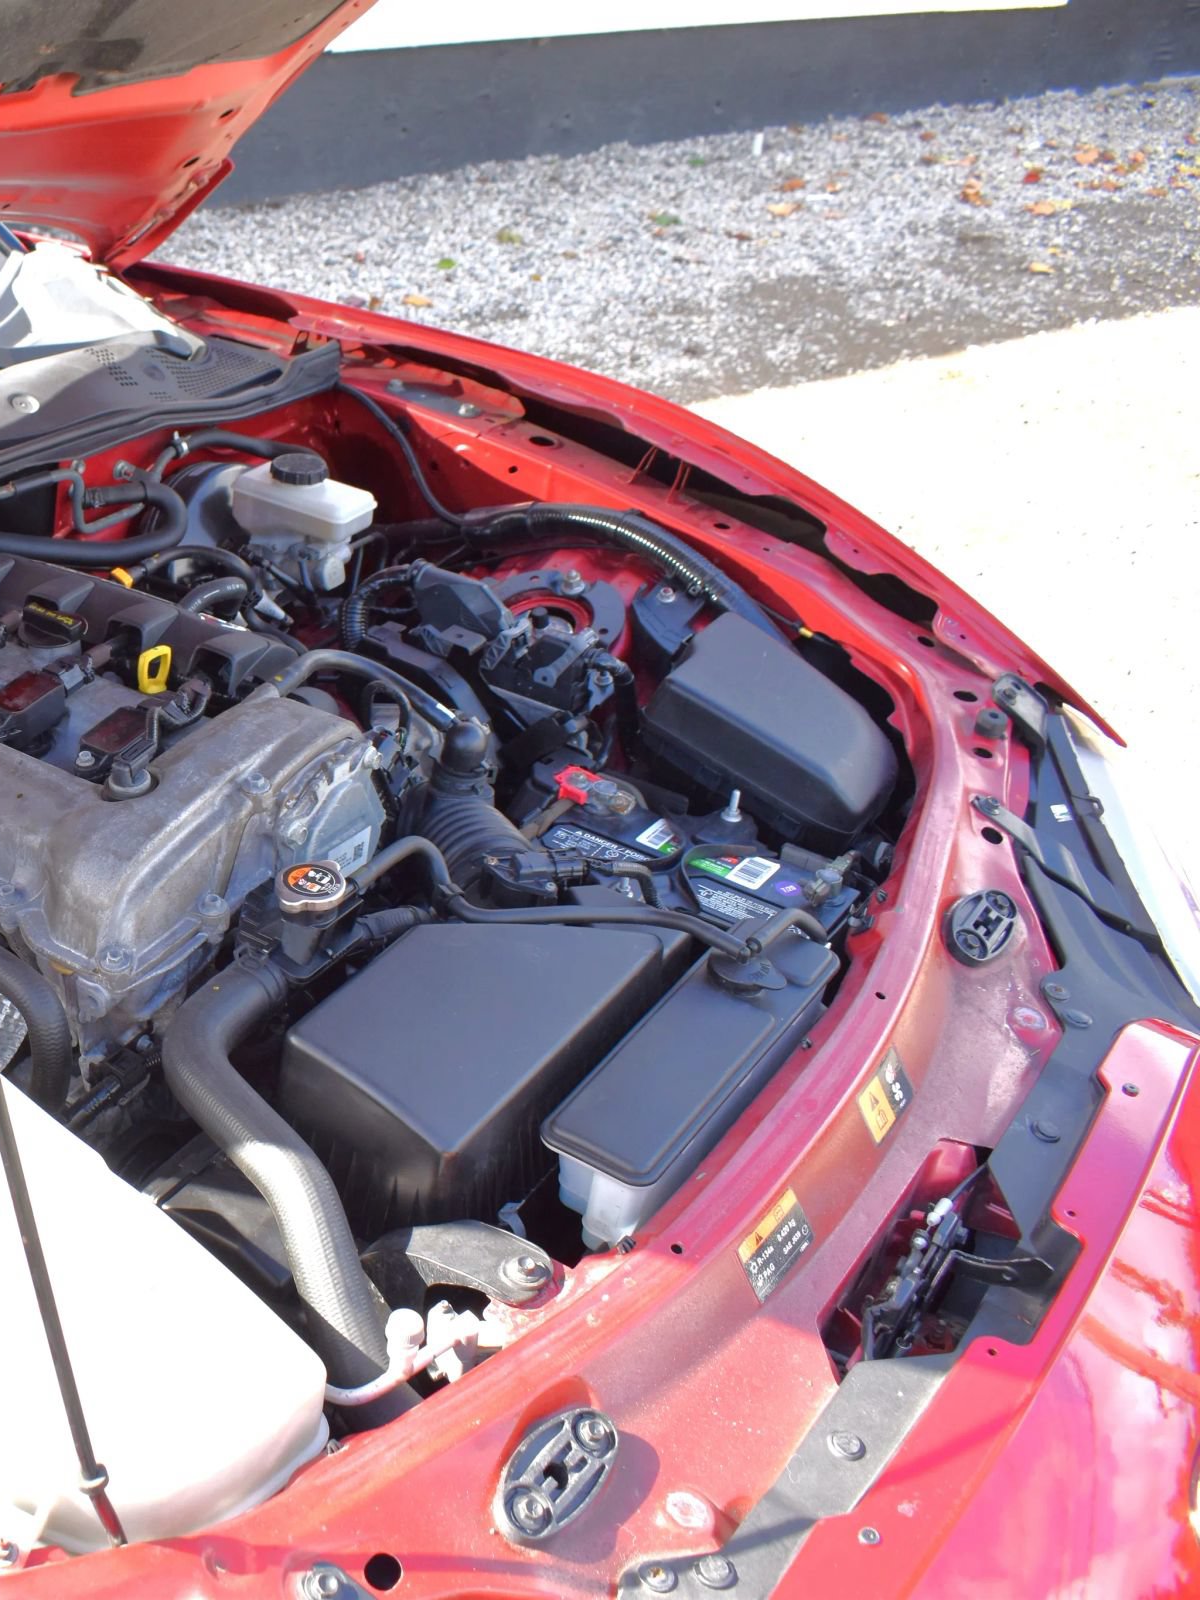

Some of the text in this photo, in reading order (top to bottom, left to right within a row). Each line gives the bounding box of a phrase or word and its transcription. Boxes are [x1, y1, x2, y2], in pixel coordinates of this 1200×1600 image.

[583, 833, 618, 849] DANGER
[624, 849, 650, 861] POISO
[757, 1245, 774, 1266] R-134a
[763, 1262, 775, 1279] PAG
[783, 1241, 793, 1255] SAE
